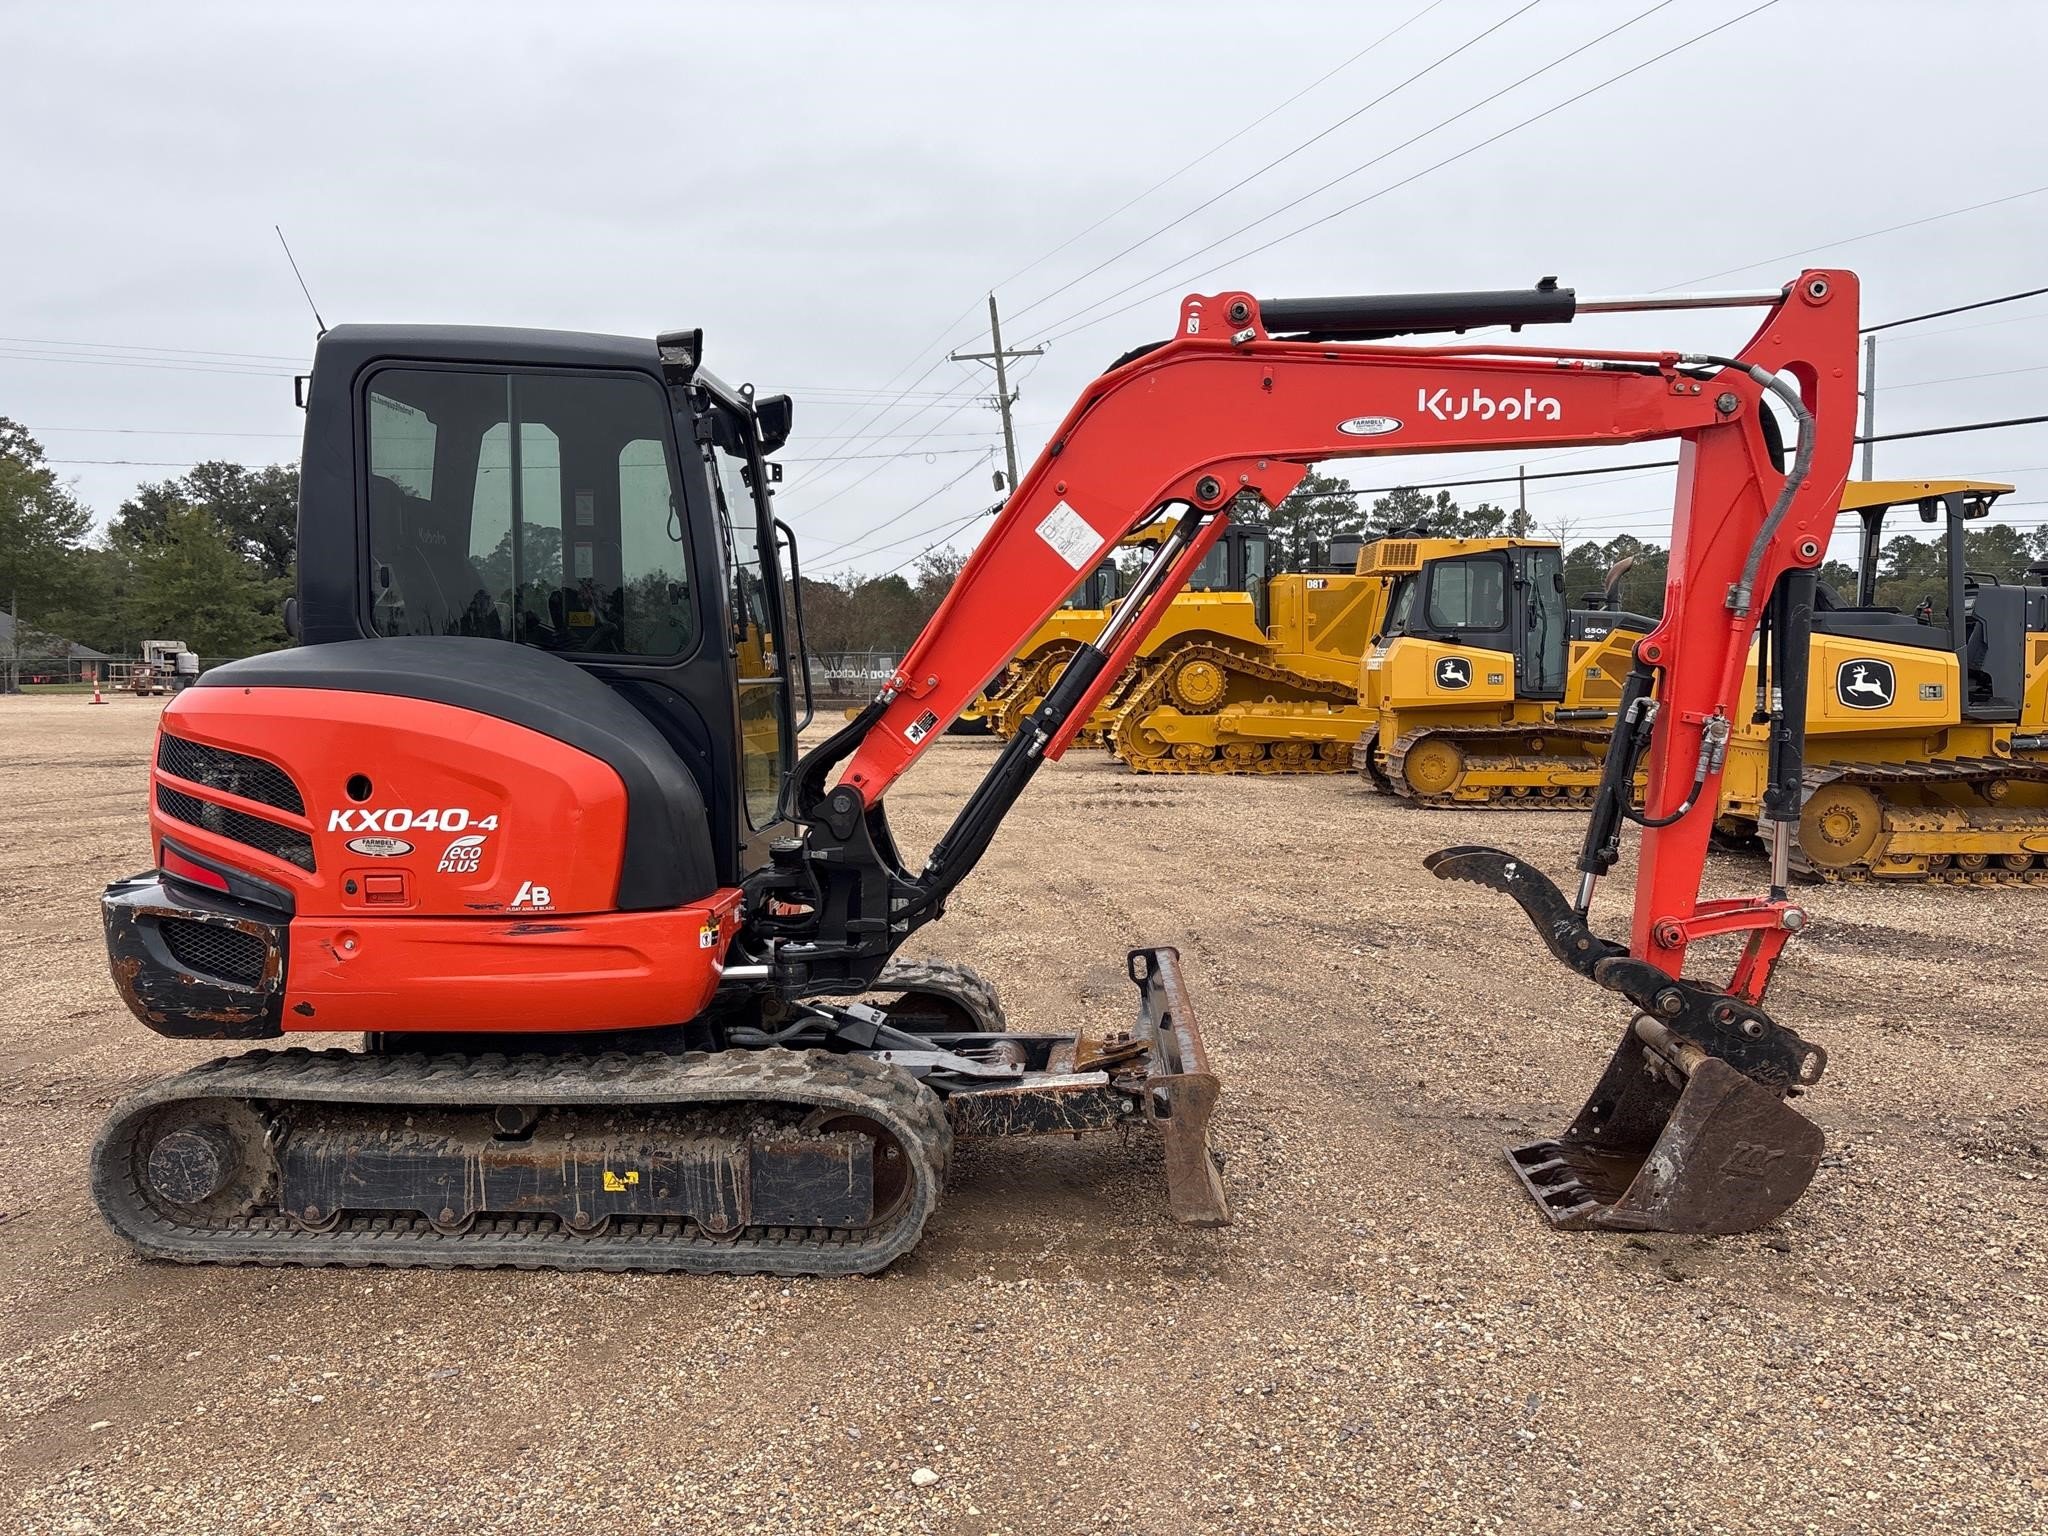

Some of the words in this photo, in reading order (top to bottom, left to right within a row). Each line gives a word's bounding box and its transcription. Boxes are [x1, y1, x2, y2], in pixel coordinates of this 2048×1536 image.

[1418, 388, 1561, 420] Kubota
[1306, 579, 1324, 589] D8T
[1584, 627, 1608, 635] 650K
[327, 808, 499, 832] KX040-4
[449, 846, 482, 860] eco
[437, 860, 479, 873] PLUS
